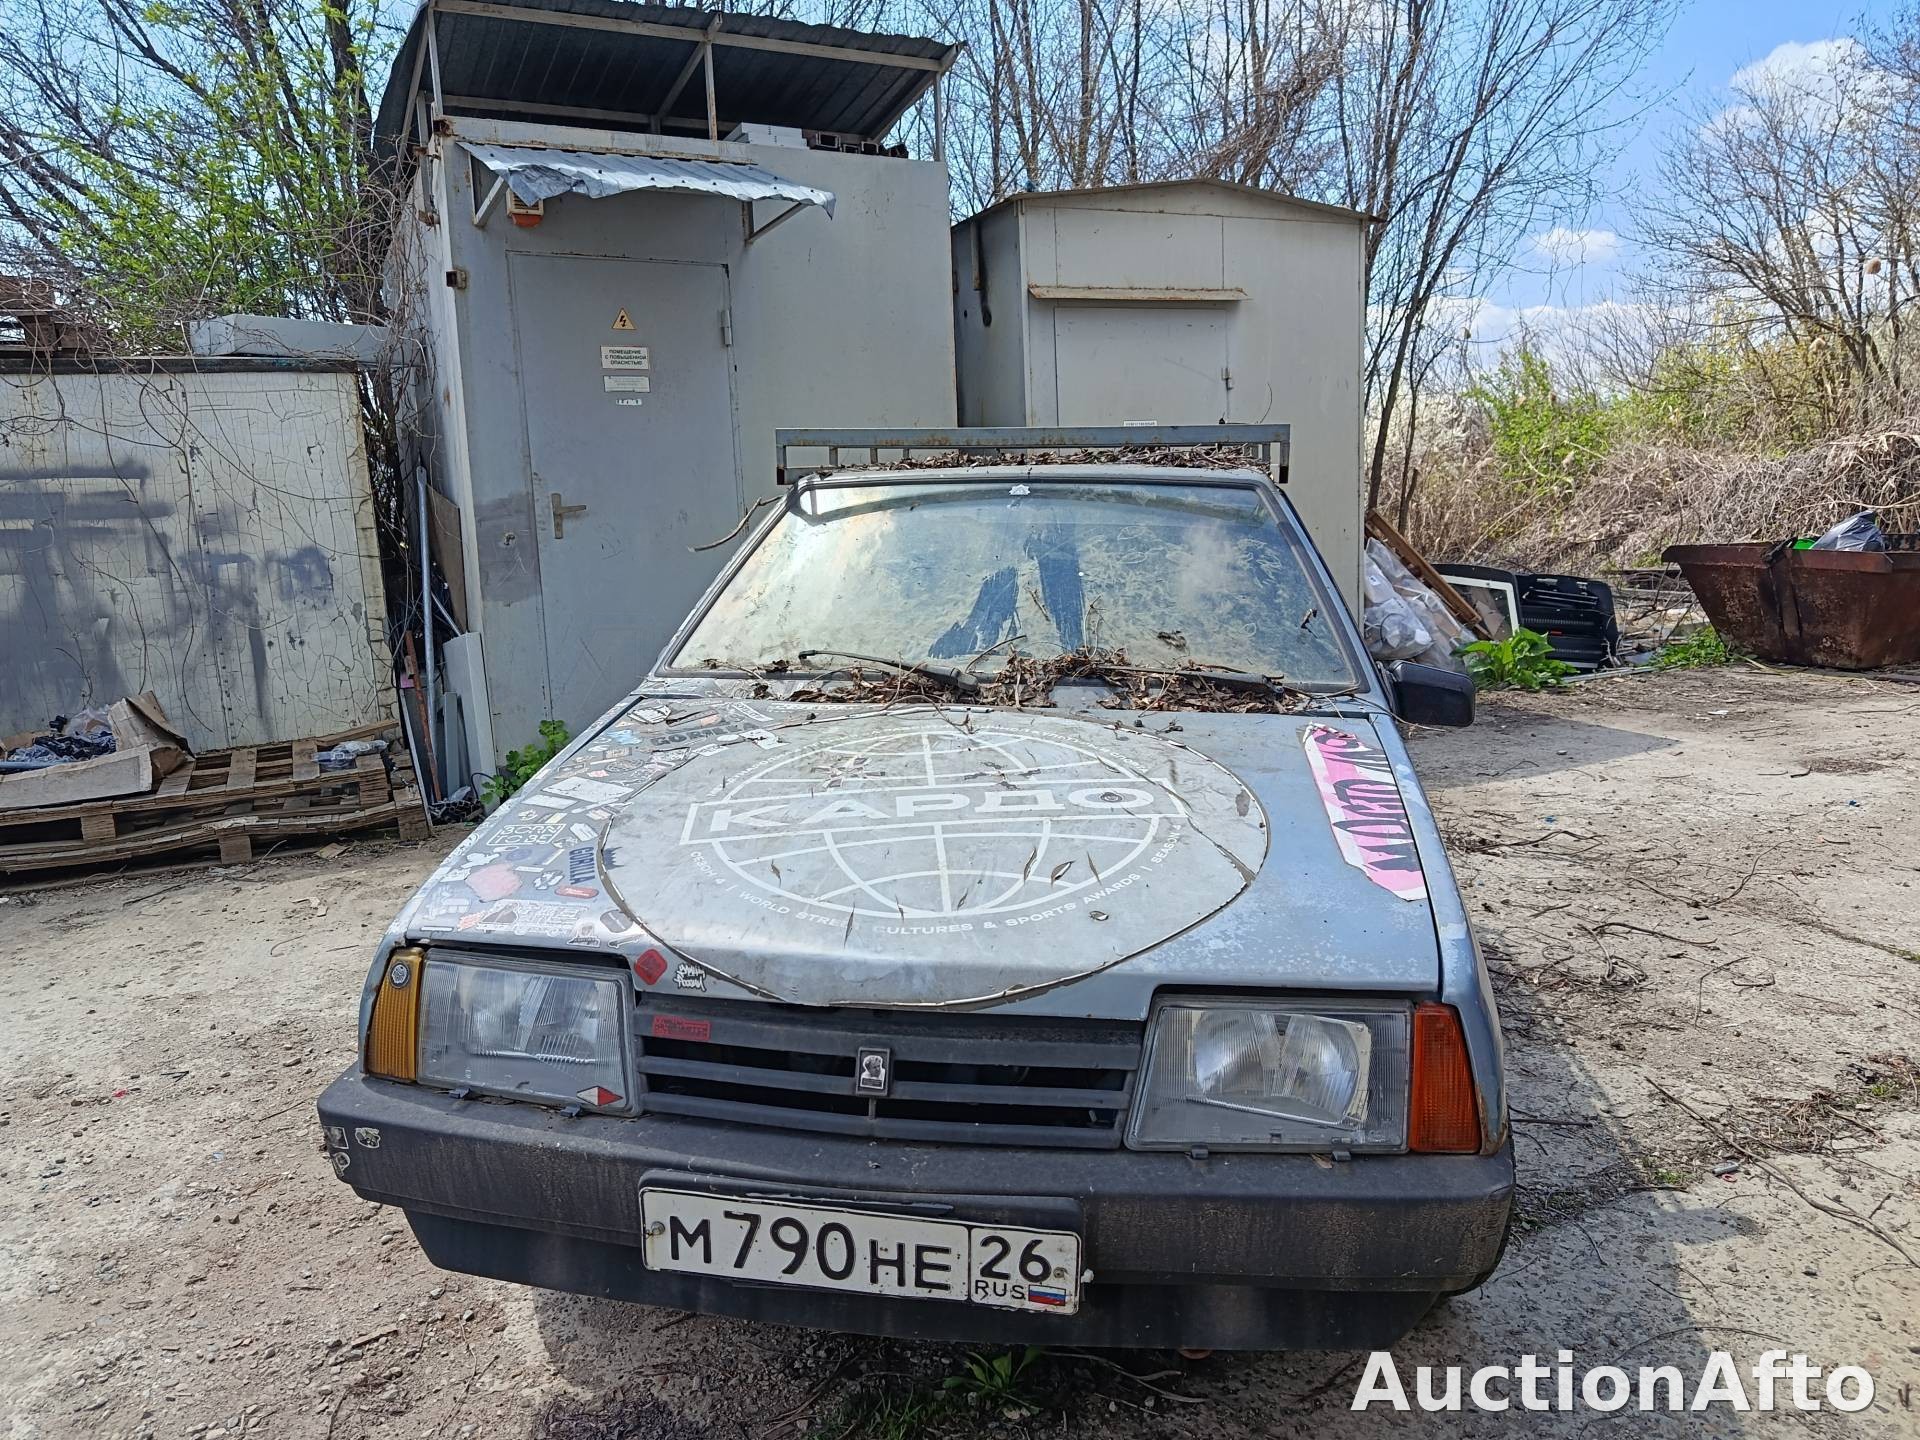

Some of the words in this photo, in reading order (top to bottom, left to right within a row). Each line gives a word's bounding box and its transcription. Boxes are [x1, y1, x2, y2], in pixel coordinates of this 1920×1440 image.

[710, 787, 1155, 832] КАРДО
[494, 835, 523, 844] TO
[500, 825, 558, 835] BORN
[568, 846, 596, 885] GORILLA
[738, 891, 791, 915] WORLD
[795, 911, 859, 930] STREE
[983, 921, 998, 929] &
[1004, 901, 1077, 927] SPORTS
[1083, 872, 1142, 905] AWARDS
[1150, 831, 1179, 864] SEASON
[978, 1234, 1054, 1284] 26
[974, 1278, 1027, 1302] RUS
